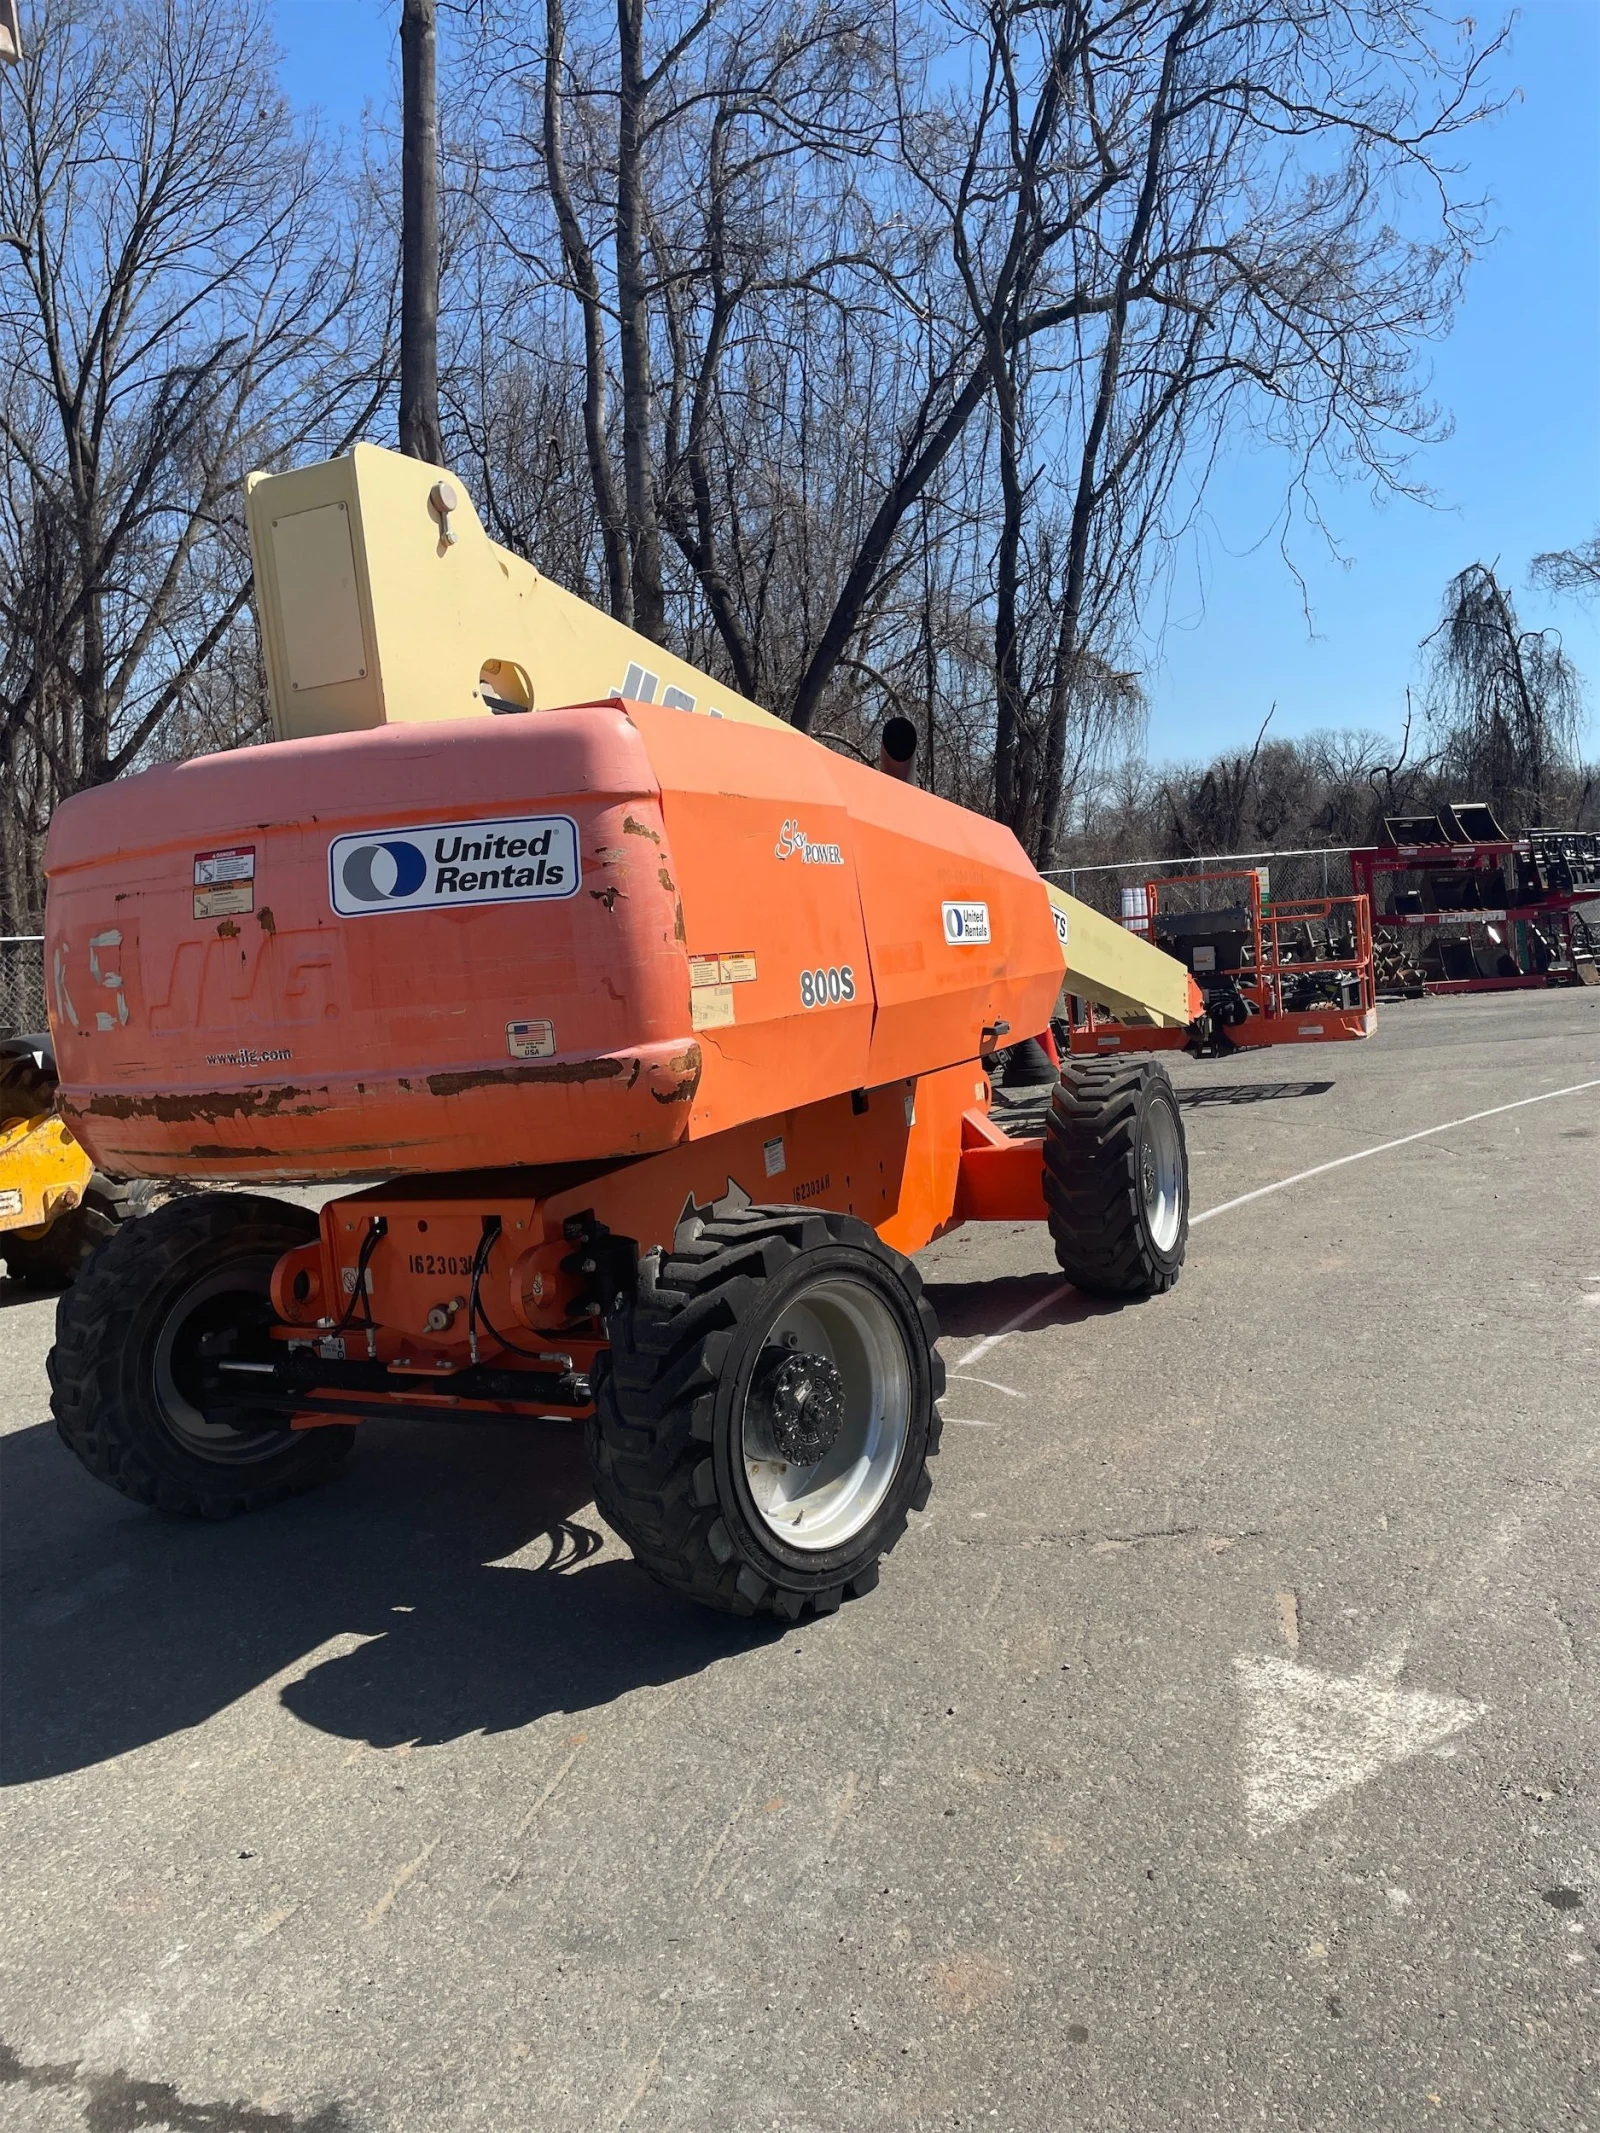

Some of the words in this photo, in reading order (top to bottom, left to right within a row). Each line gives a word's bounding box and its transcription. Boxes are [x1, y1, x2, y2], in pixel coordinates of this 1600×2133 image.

[434, 829, 553, 864] United
[804, 844, 843, 864] POWER
[434, 859, 565, 894] Rentals
[963, 909, 984, 923] United
[1052, 911, 1067, 938] TS
[964, 924, 988, 938] Rentals
[800, 965, 855, 1008] 800S
[205, 1048, 293, 1068] www.jlg.com
